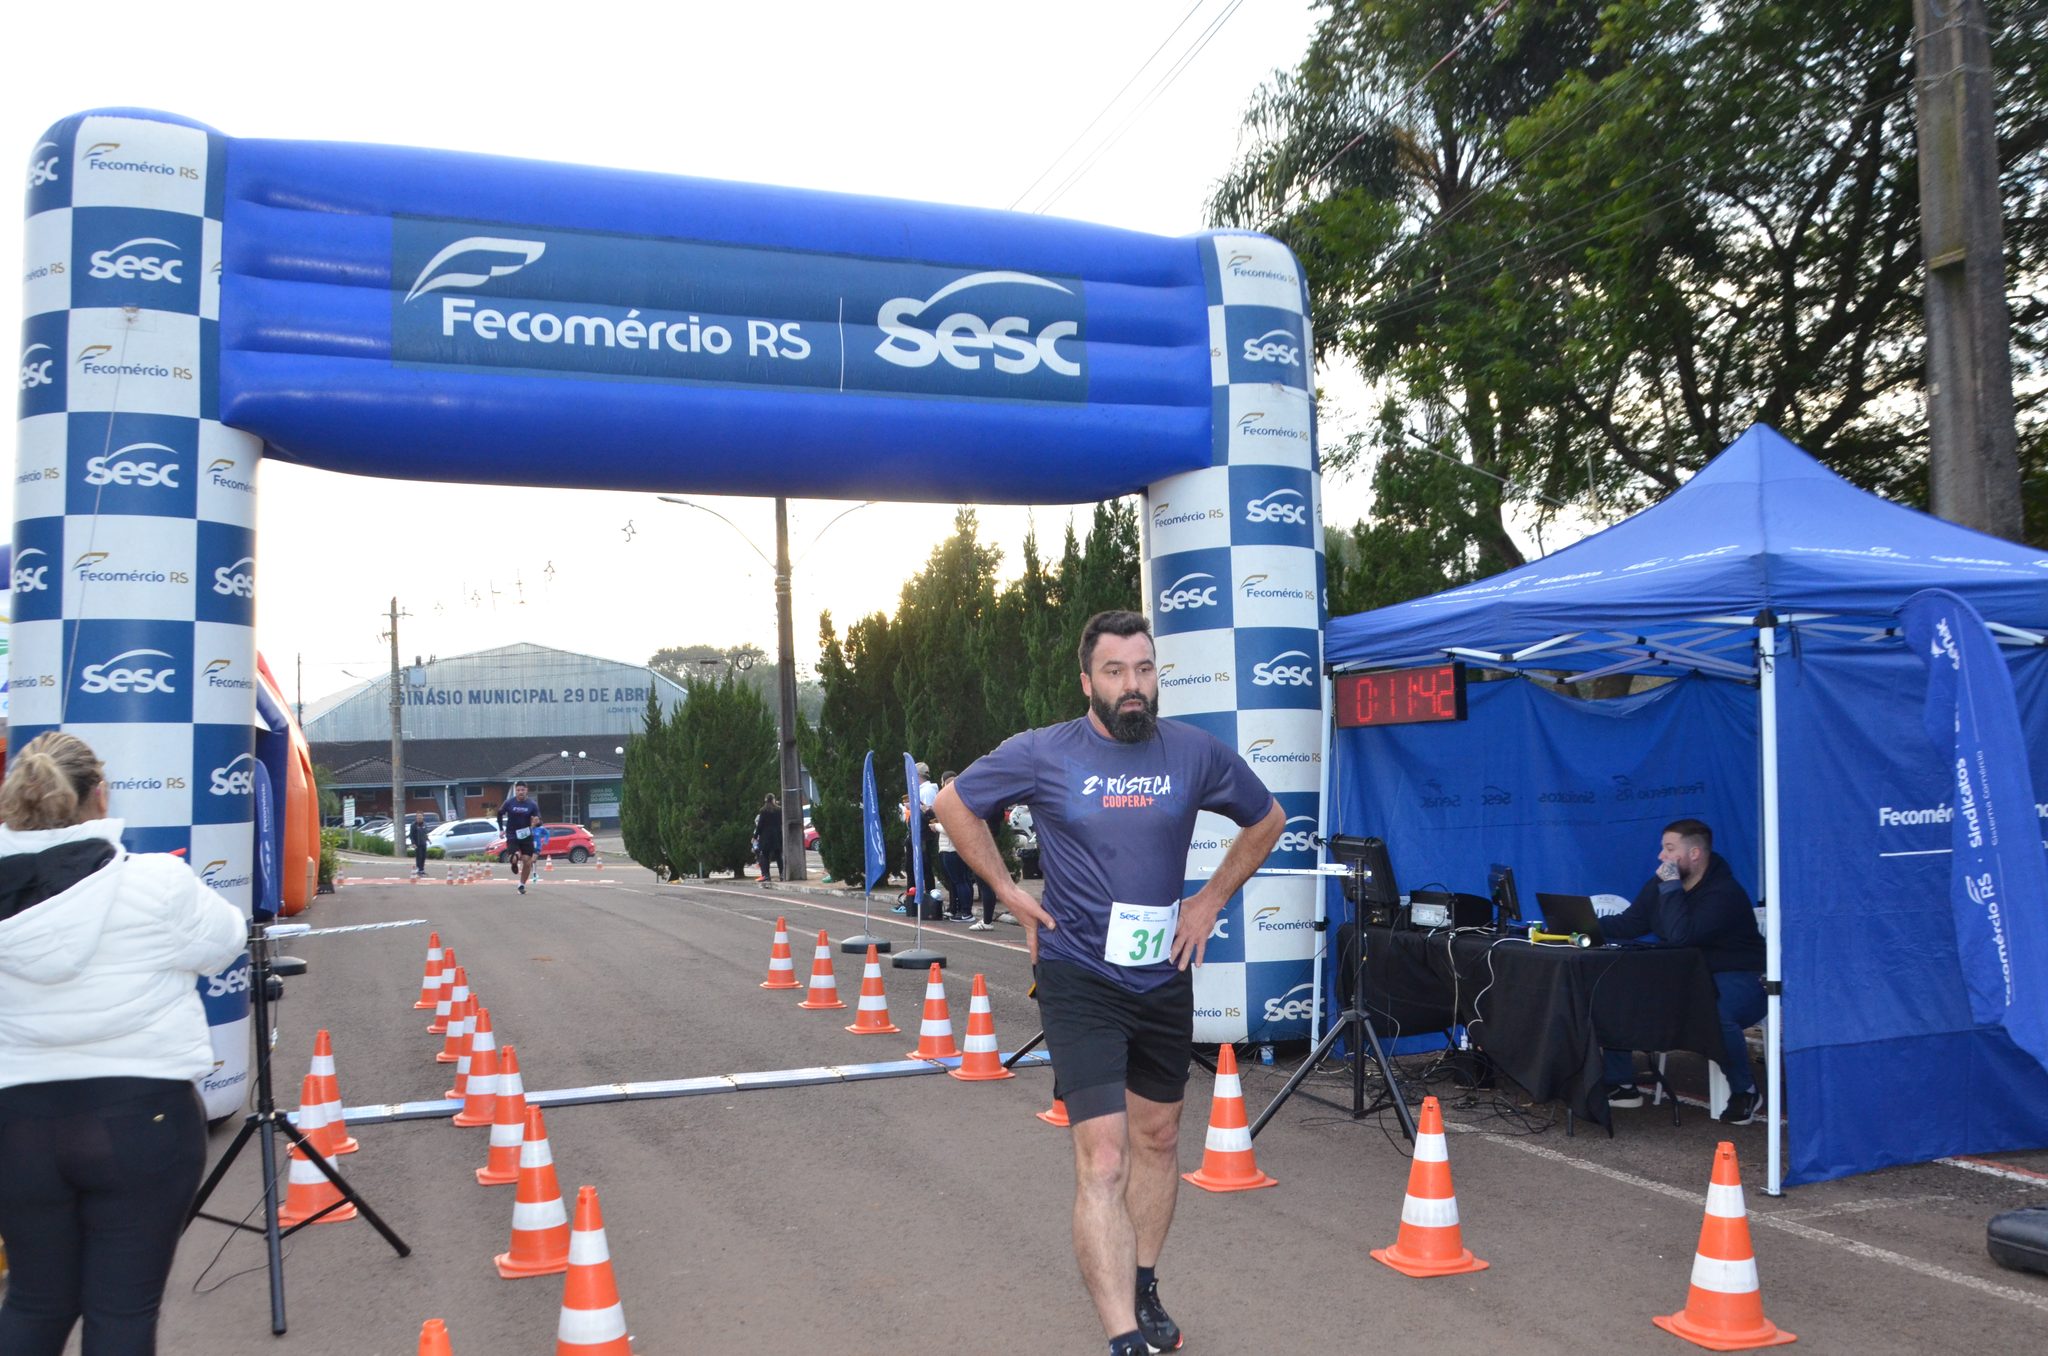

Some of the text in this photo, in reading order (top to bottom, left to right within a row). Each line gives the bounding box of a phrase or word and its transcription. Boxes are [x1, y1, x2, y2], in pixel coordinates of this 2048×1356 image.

[89, 158, 200, 180] Fecomércio RS
[50, 262, 65, 275] RS
[88, 249, 183, 284] Sesc
[1234, 266, 1288, 283] Fecomércio
[442, 296, 812, 361] Fecomércio RS
[873, 295, 1081, 377] Sesc
[1243, 337, 1300, 367] Sesc
[84, 361, 193, 381] Fecomércio RS
[1243, 425, 1309, 442] Fecomércio RS
[44, 467, 60, 480] RS
[84, 456, 180, 489] Sesc
[1154, 508, 1224, 528] Fecomércio RS
[1246, 498, 1307, 525] Sesc
[79, 568, 190, 584] Fecomércio RS
[1159, 586, 1218, 613] Sesc
[1246, 587, 1304, 599] Fecomércio
[1304, 590, 1315, 601] RS
[40, 675, 56, 688] RS
[80, 663, 176, 694] Sesc
[1160, 672, 1231, 688] Fecomércio RS
[1252, 662, 1313, 687] Sesc
[468, 688, 559, 705] MUNICIPAL
[563, 687, 585, 704] 29
[589, 687, 609, 703] DE
[614, 687, 650, 703] ABRI
[1356, 667, 1455, 724] 0:11:42
[1253, 751, 1310, 764] Fecomércio
[166, 777, 186, 789] RS
[1106, 773, 1172, 797] RÚSTICA
[1102, 795, 1154, 809] COOPERA+
[1956, 757, 1984, 849] Sindicatos
[1976, 872, 1997, 899] RS
[1128, 927, 1166, 961] 31
[1224, 1007, 1241, 1018] RS
